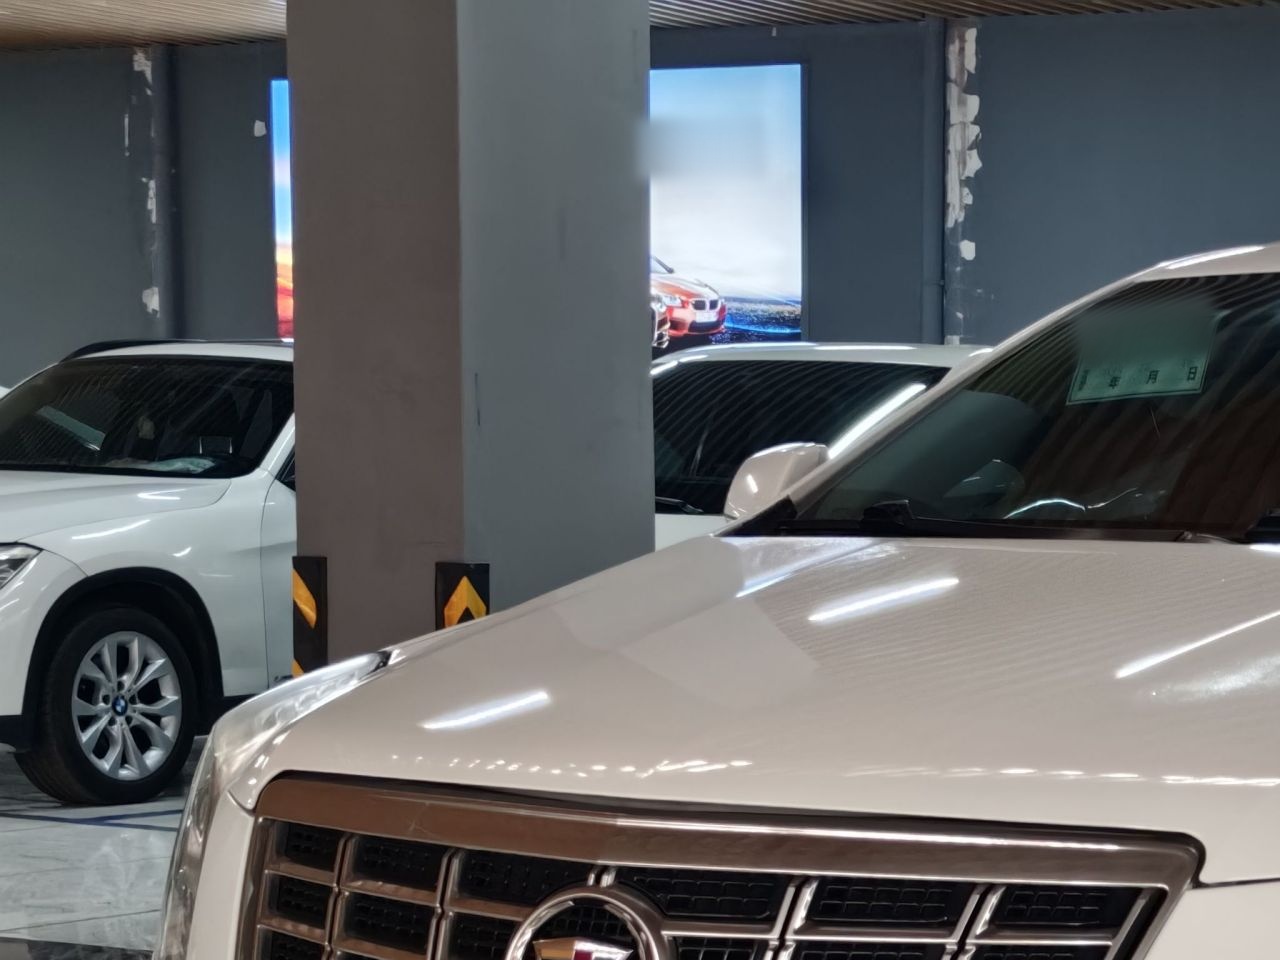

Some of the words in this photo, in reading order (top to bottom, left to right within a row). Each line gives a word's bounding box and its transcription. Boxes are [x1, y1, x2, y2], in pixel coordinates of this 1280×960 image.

[1108, 376, 1122, 390] 年
[1145, 369, 1161, 384] 月
[1186, 366, 1199, 382] 日
